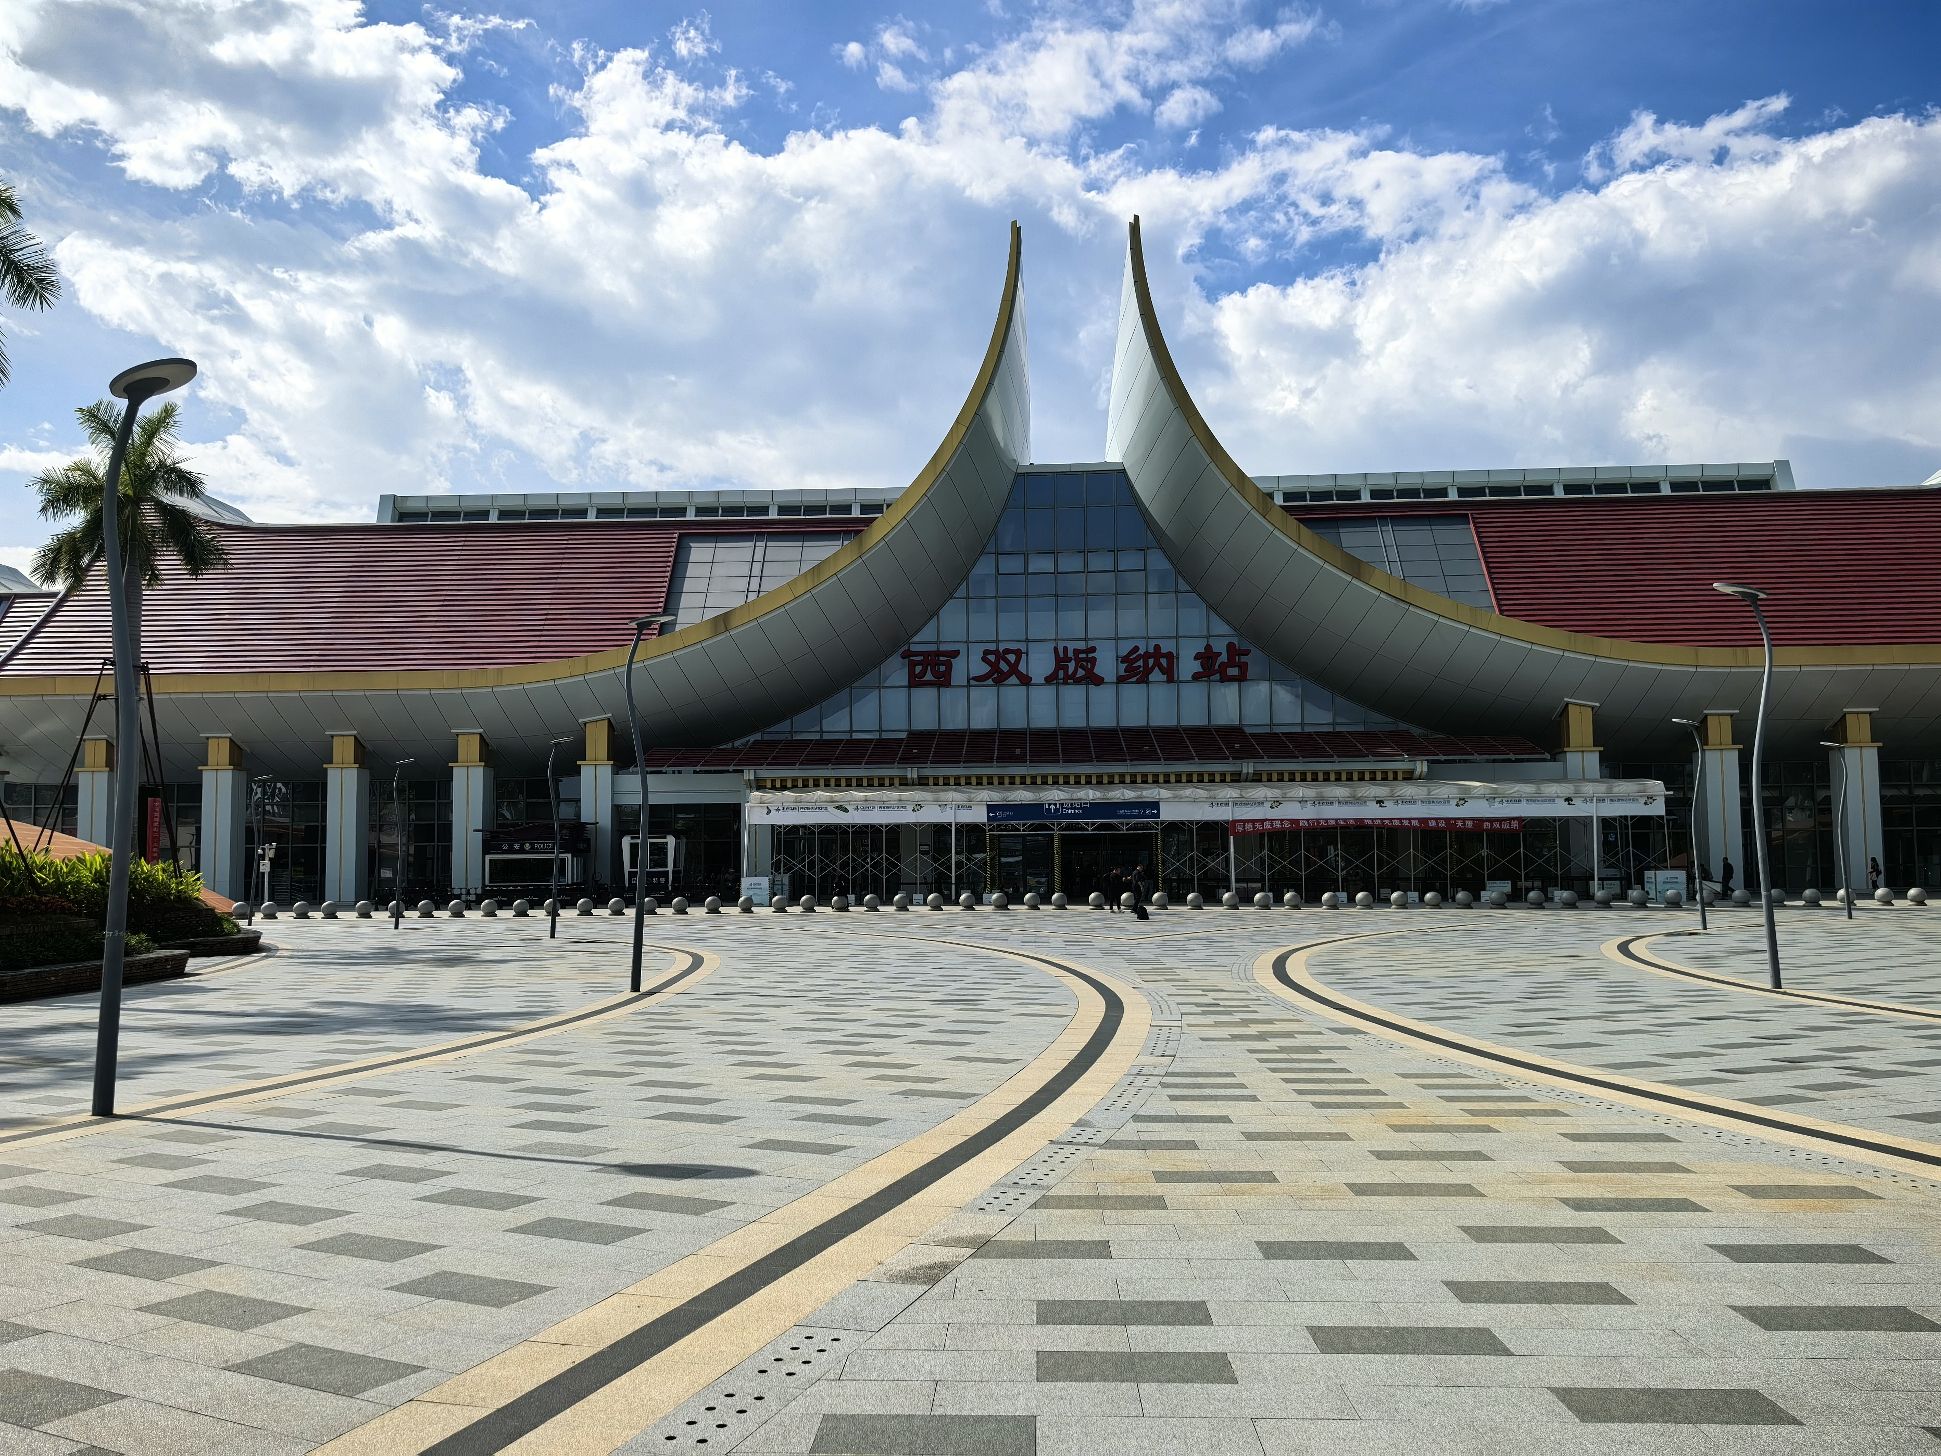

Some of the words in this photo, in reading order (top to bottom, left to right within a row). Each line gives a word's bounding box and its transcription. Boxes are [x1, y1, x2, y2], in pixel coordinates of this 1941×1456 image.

[901, 642, 1251, 686] 西双版纳站
